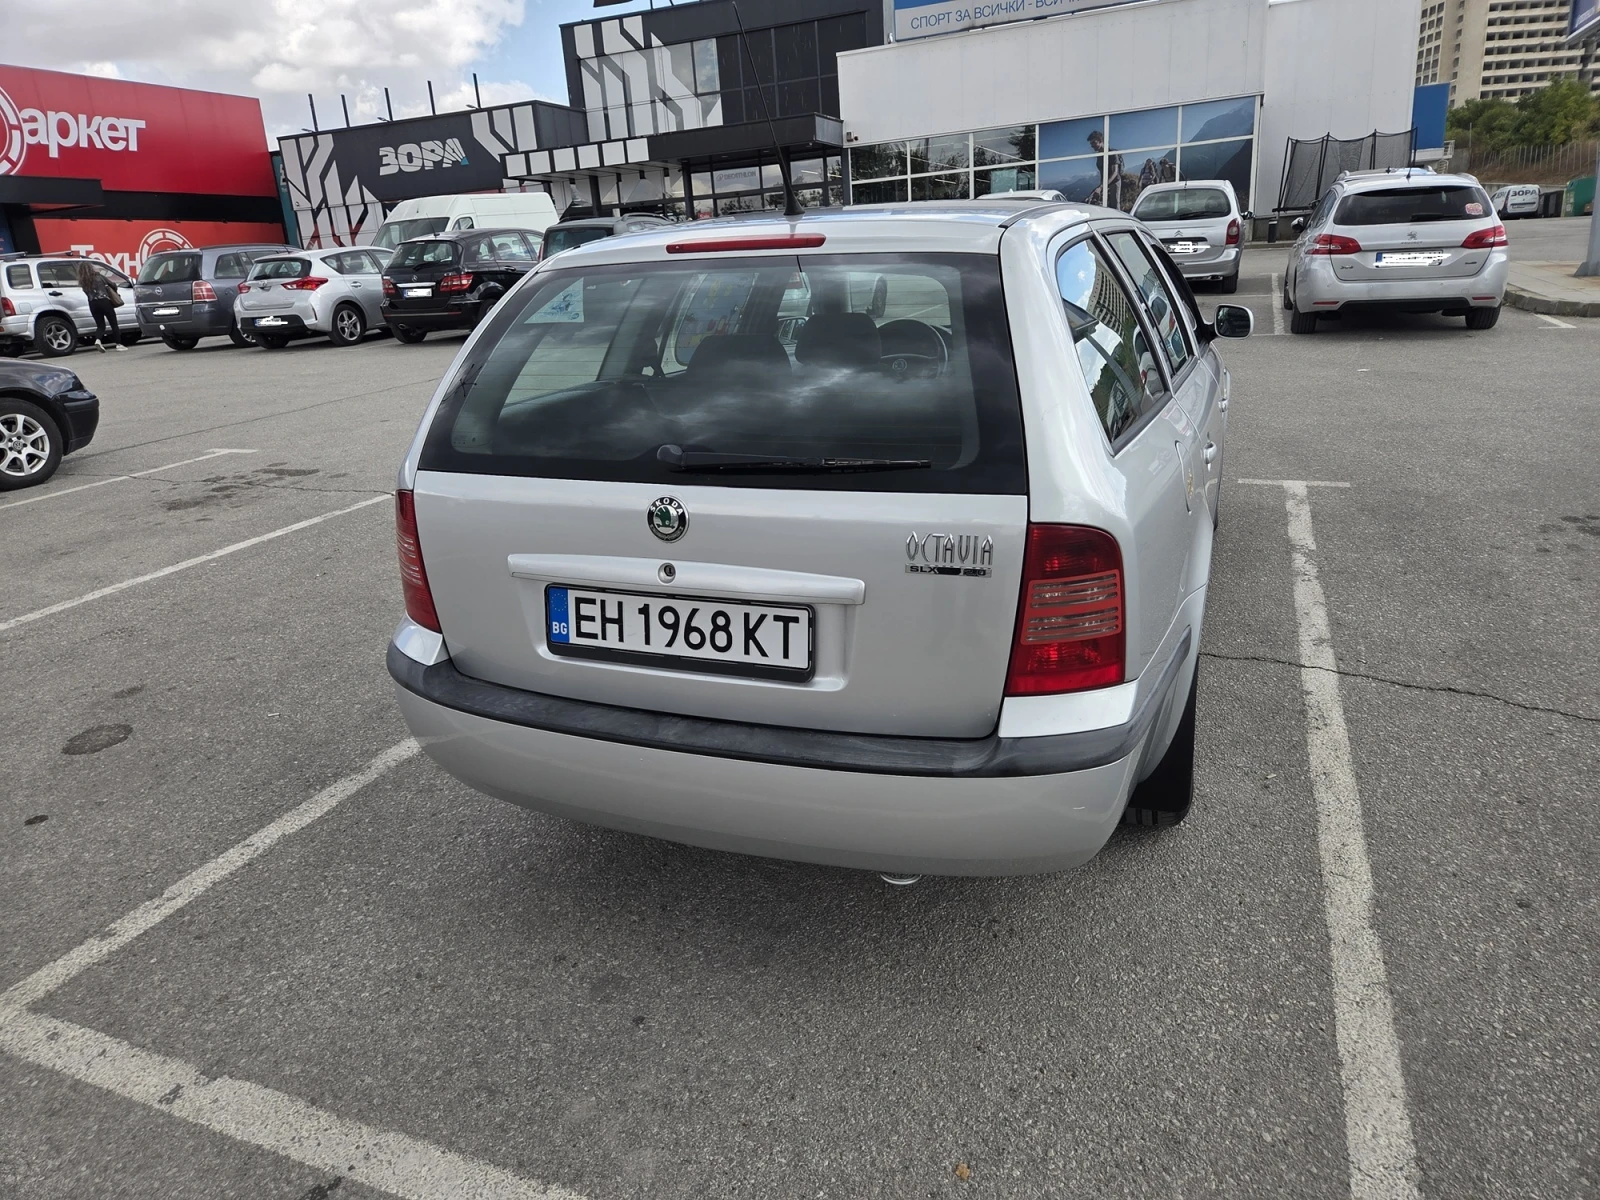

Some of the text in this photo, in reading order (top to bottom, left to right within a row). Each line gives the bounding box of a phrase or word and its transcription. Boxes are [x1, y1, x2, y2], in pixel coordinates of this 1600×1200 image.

[911, 12, 953, 30] СПОРТ
[955, 10, 972, 22] ЗА
[974, 0, 1026, 20] ВСИЧКИ
[379, 137, 469, 176] ЗОРА
[724, 171, 757, 180] DECATHLON
[1511, 189, 1538, 197] ЗОРА
[905, 531, 993, 566] OCTAVIA
[909, 565, 937, 574] SLX
[552, 621, 568, 635] BG
[574, 596, 800, 660] EH 1968 KT
